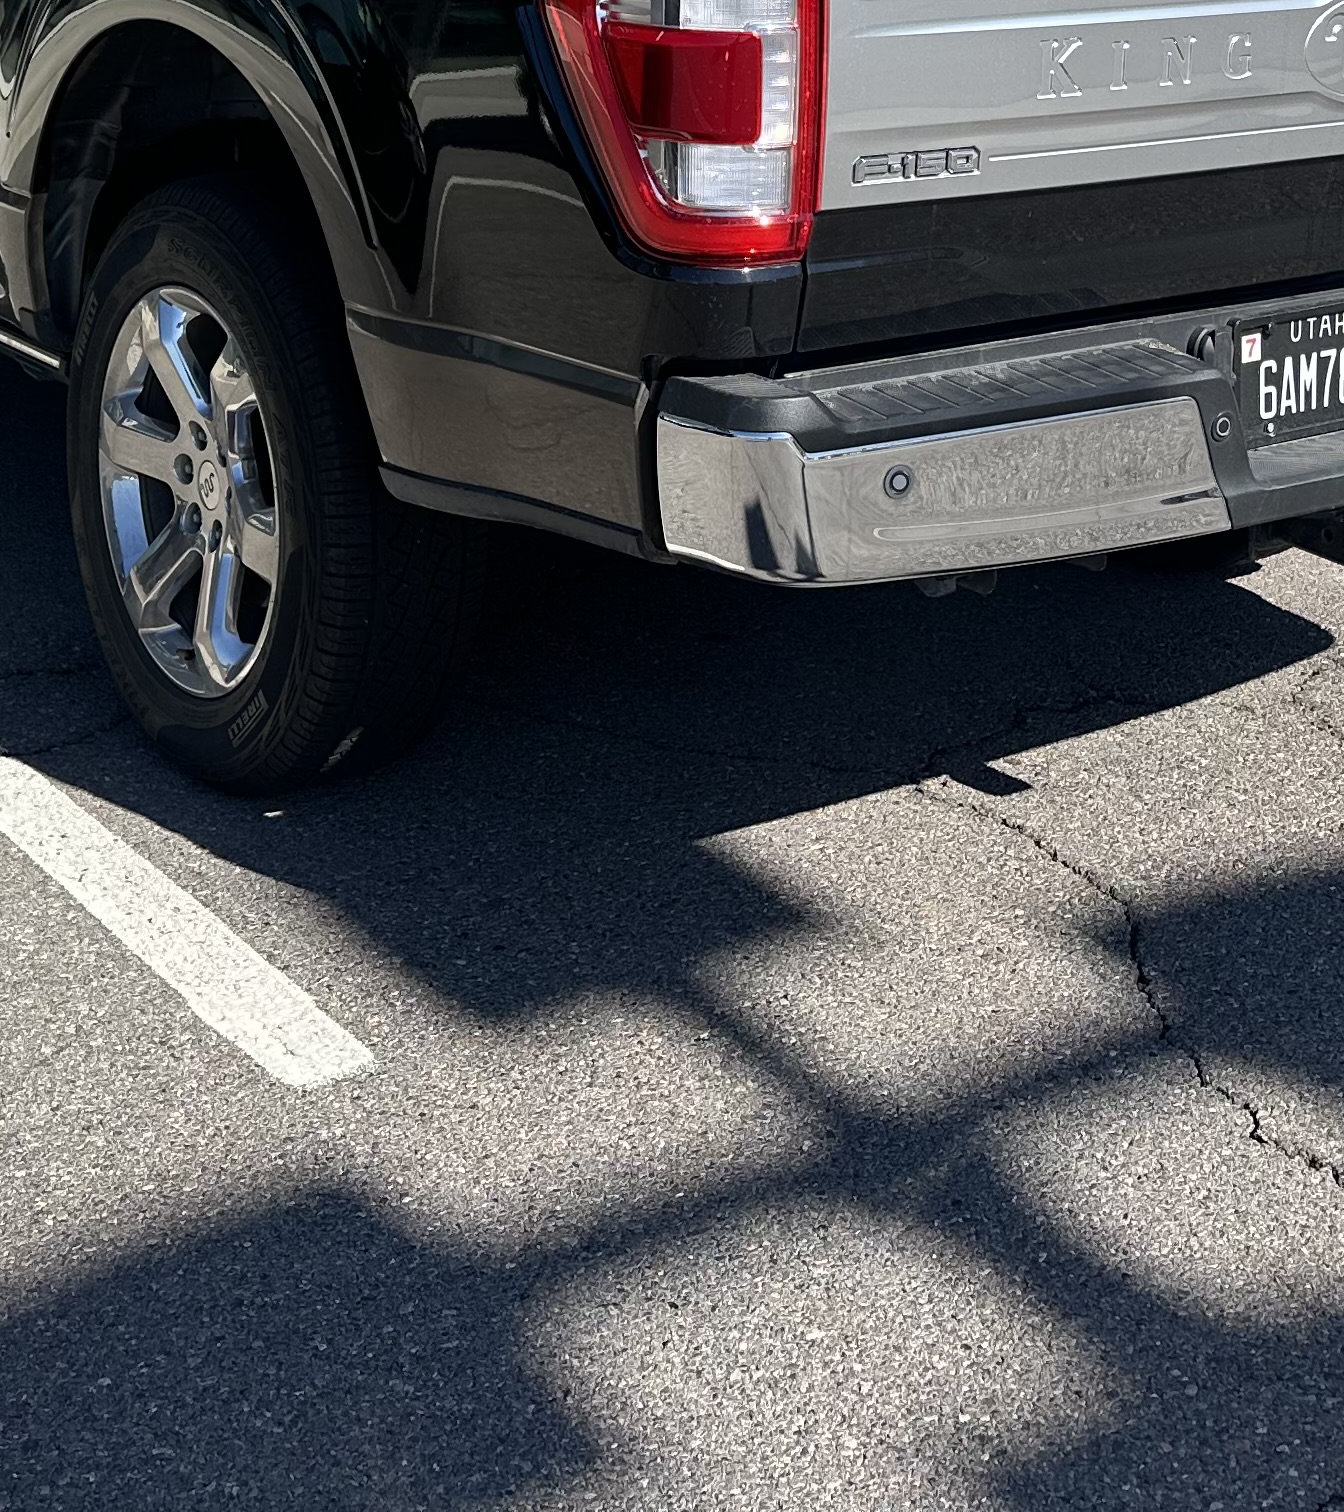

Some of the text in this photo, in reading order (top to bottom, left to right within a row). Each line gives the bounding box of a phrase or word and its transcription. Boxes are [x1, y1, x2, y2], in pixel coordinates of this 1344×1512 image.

[1036, 33, 1253, 100] KING
[851, 145, 981, 187] F-150
[1245, 338, 1257, 358] 7
